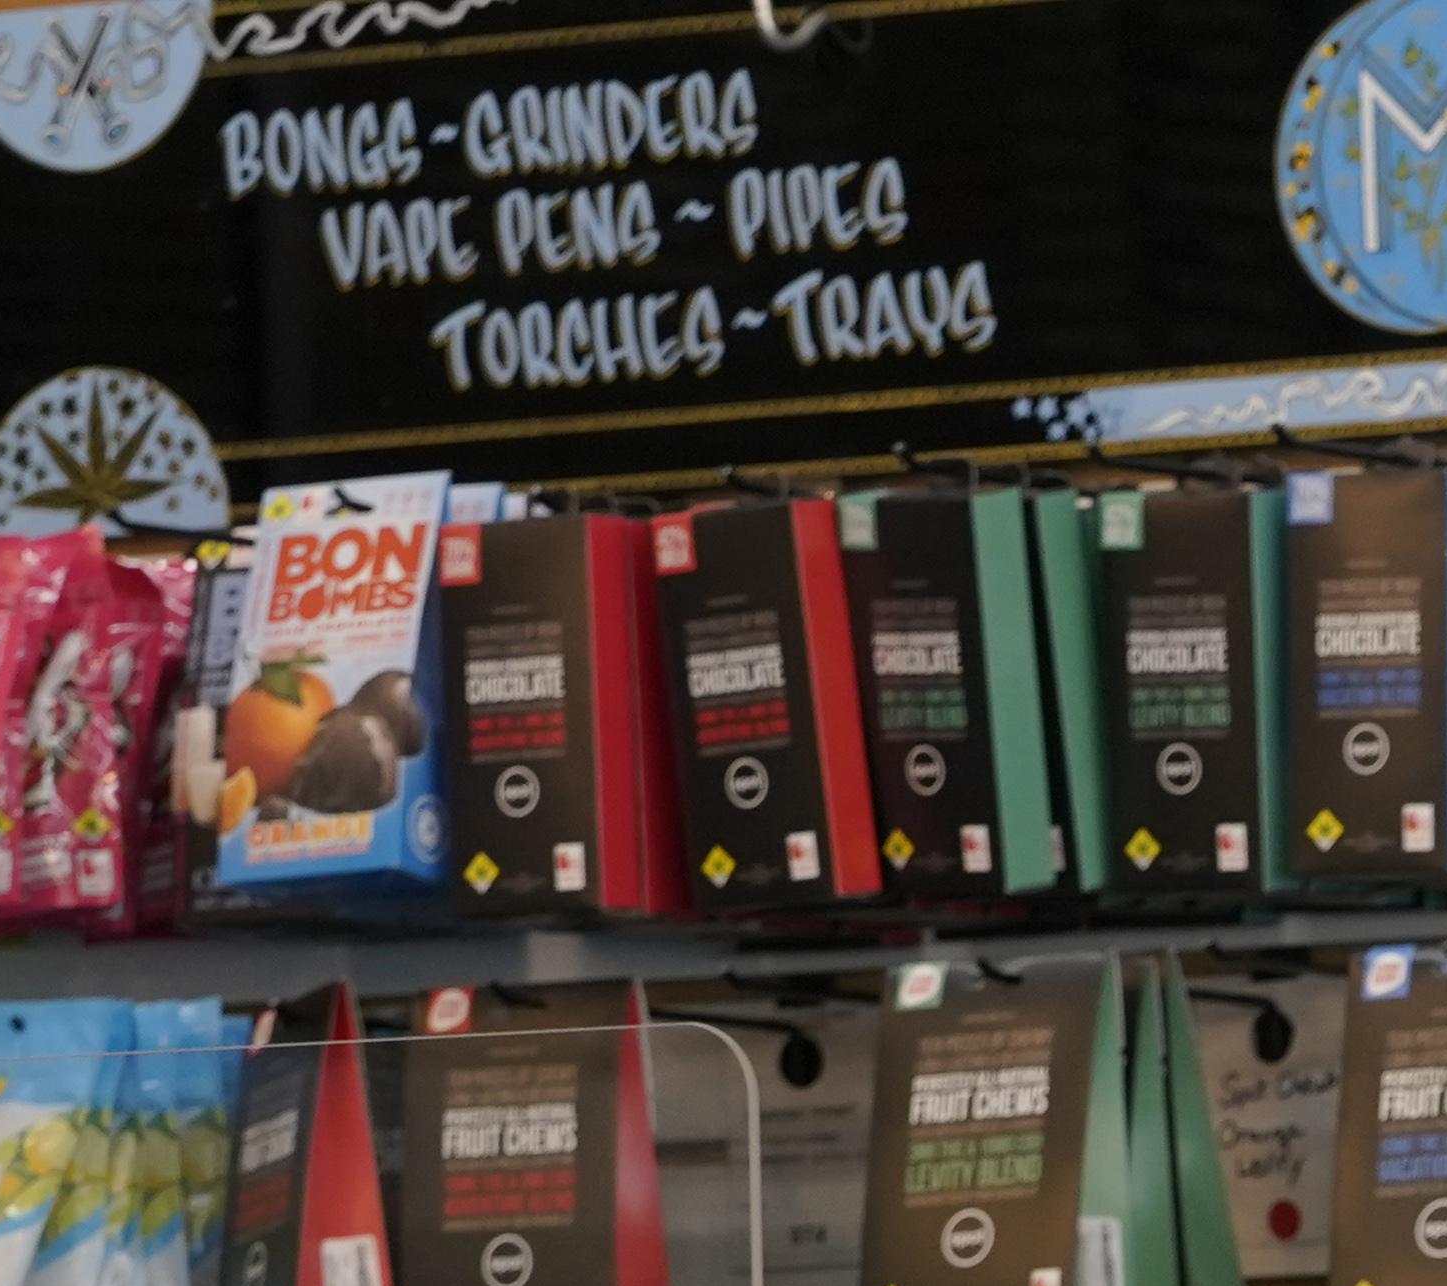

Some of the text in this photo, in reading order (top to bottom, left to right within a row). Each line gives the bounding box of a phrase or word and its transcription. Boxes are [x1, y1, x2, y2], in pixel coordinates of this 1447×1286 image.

[319, 155, 909, 294] VAPE PENS PIPES
[431, 261, 997, 396] TORCHES TRAYS
[274, 522, 428, 584] BON
[267, 579, 418, 623] BOMBS
[246, 812, 374, 846] ORANGE
[910, 1091, 972, 1126] FRUIT
[1380, 1087, 1440, 1120] FRUIT
[442, 1125, 503, 1161] FRUIT
